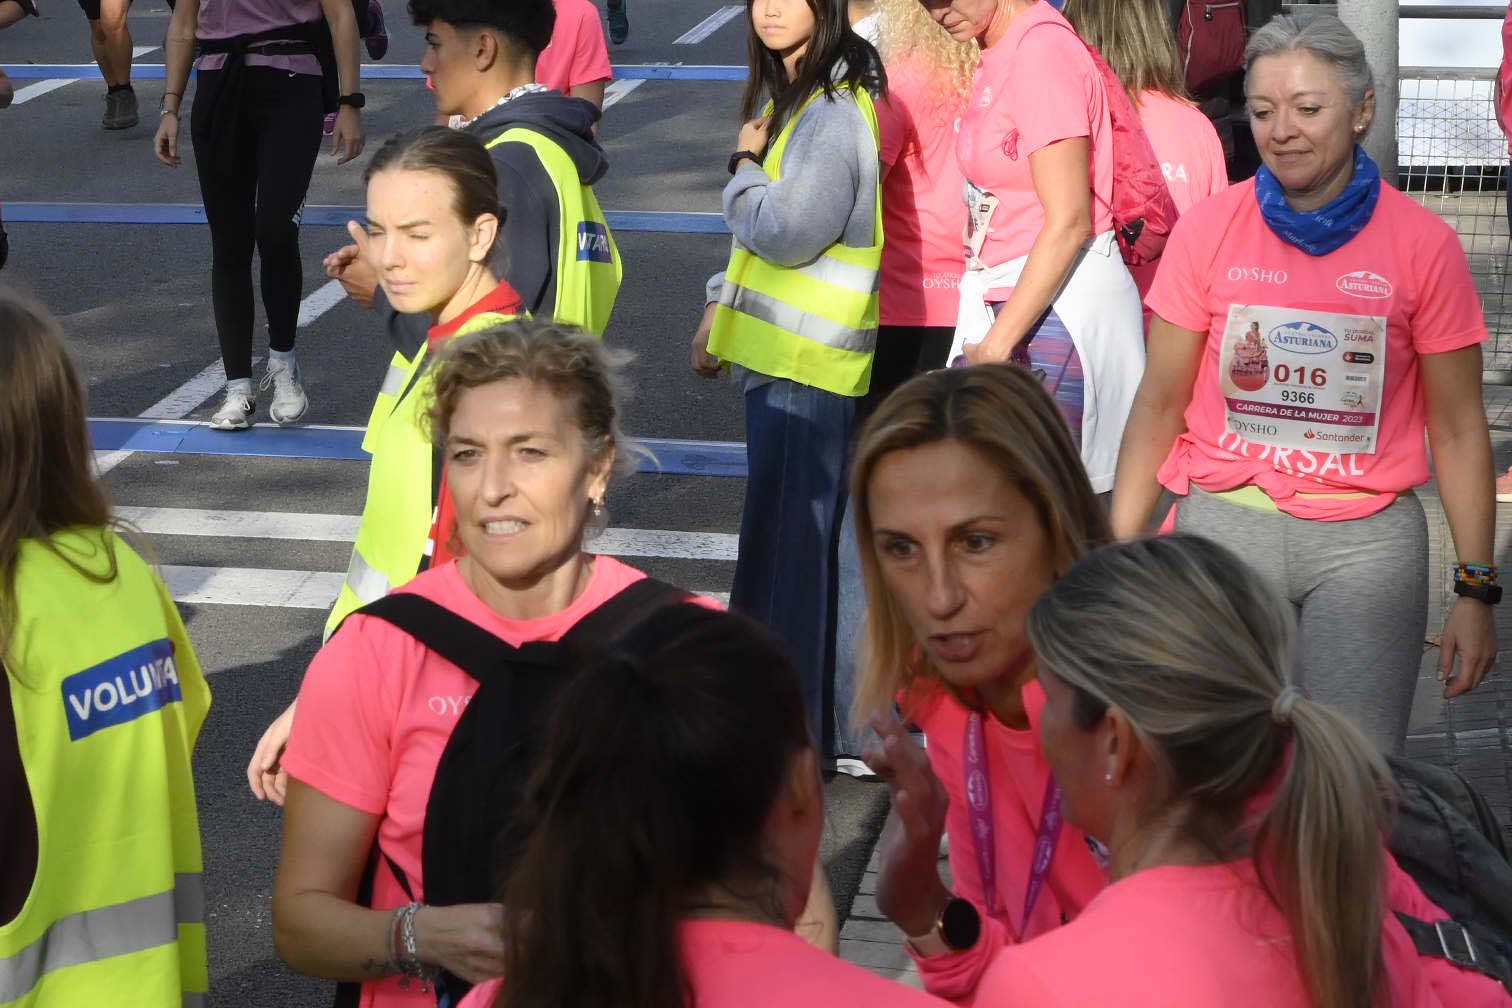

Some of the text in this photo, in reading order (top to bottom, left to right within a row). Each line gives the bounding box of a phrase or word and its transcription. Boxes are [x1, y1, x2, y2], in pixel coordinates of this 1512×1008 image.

[922, 277, 964, 290] OYSH
[1228, 267, 1287, 284] OYSHO
[1341, 279, 1389, 295] ASTURIANA
[1274, 331, 1333, 349] ASTURIANA
[1344, 333, 1374, 343] SUMA
[1273, 364, 1327, 387] 016
[1282, 390, 1314, 405] 9366
[1236, 403, 1363, 423] CARRERA DE LA MUJER 2023
[1316, 431, 1364, 442] Santander
